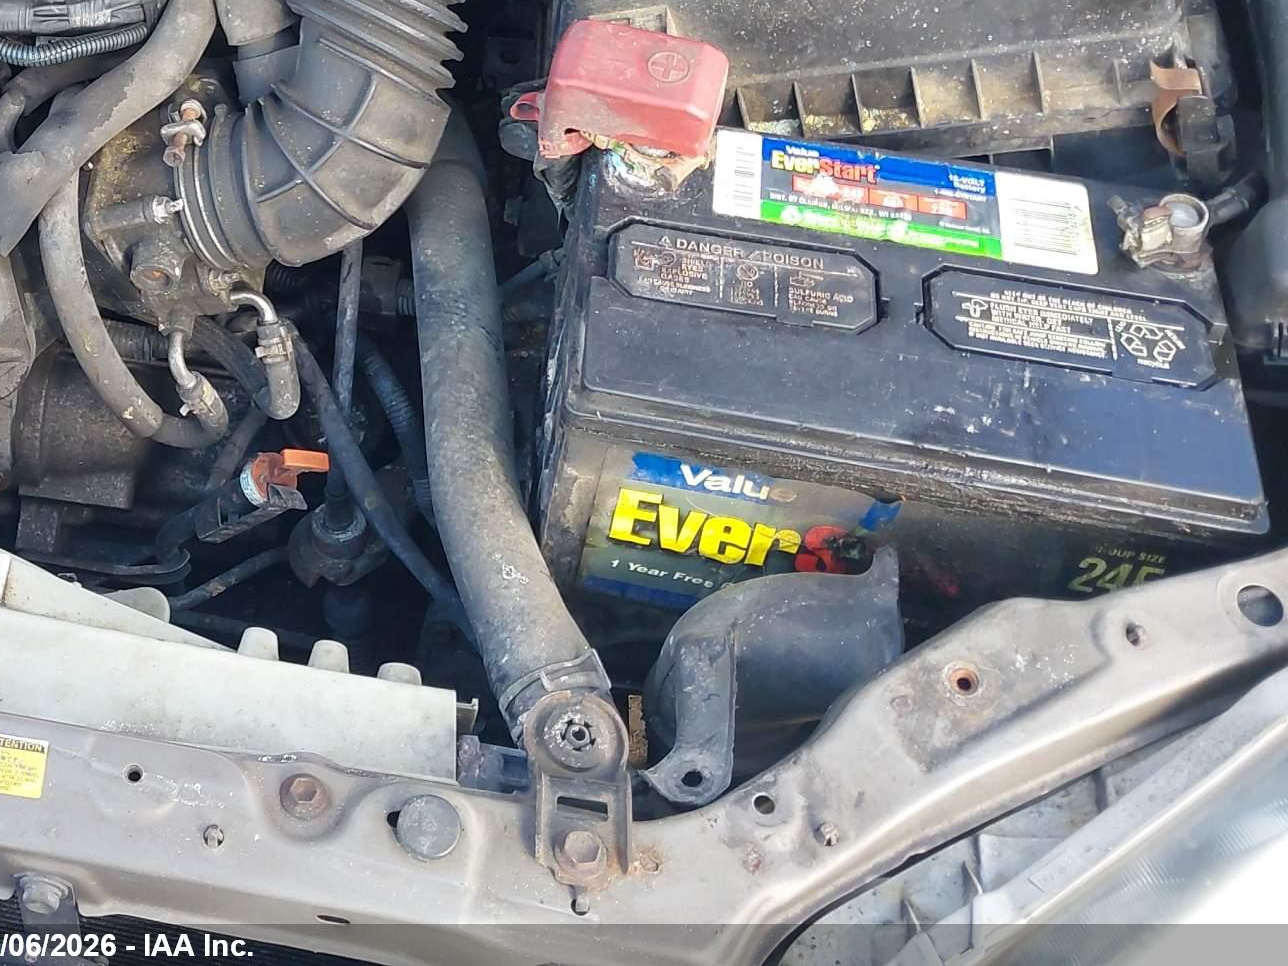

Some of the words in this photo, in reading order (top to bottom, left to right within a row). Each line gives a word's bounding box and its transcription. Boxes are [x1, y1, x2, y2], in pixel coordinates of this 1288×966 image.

[770, 148, 878, 185] EverStart
[675, 237, 745, 259] DANGER
[762, 248, 825, 270] POISON
[628, 561, 669, 577] Year
